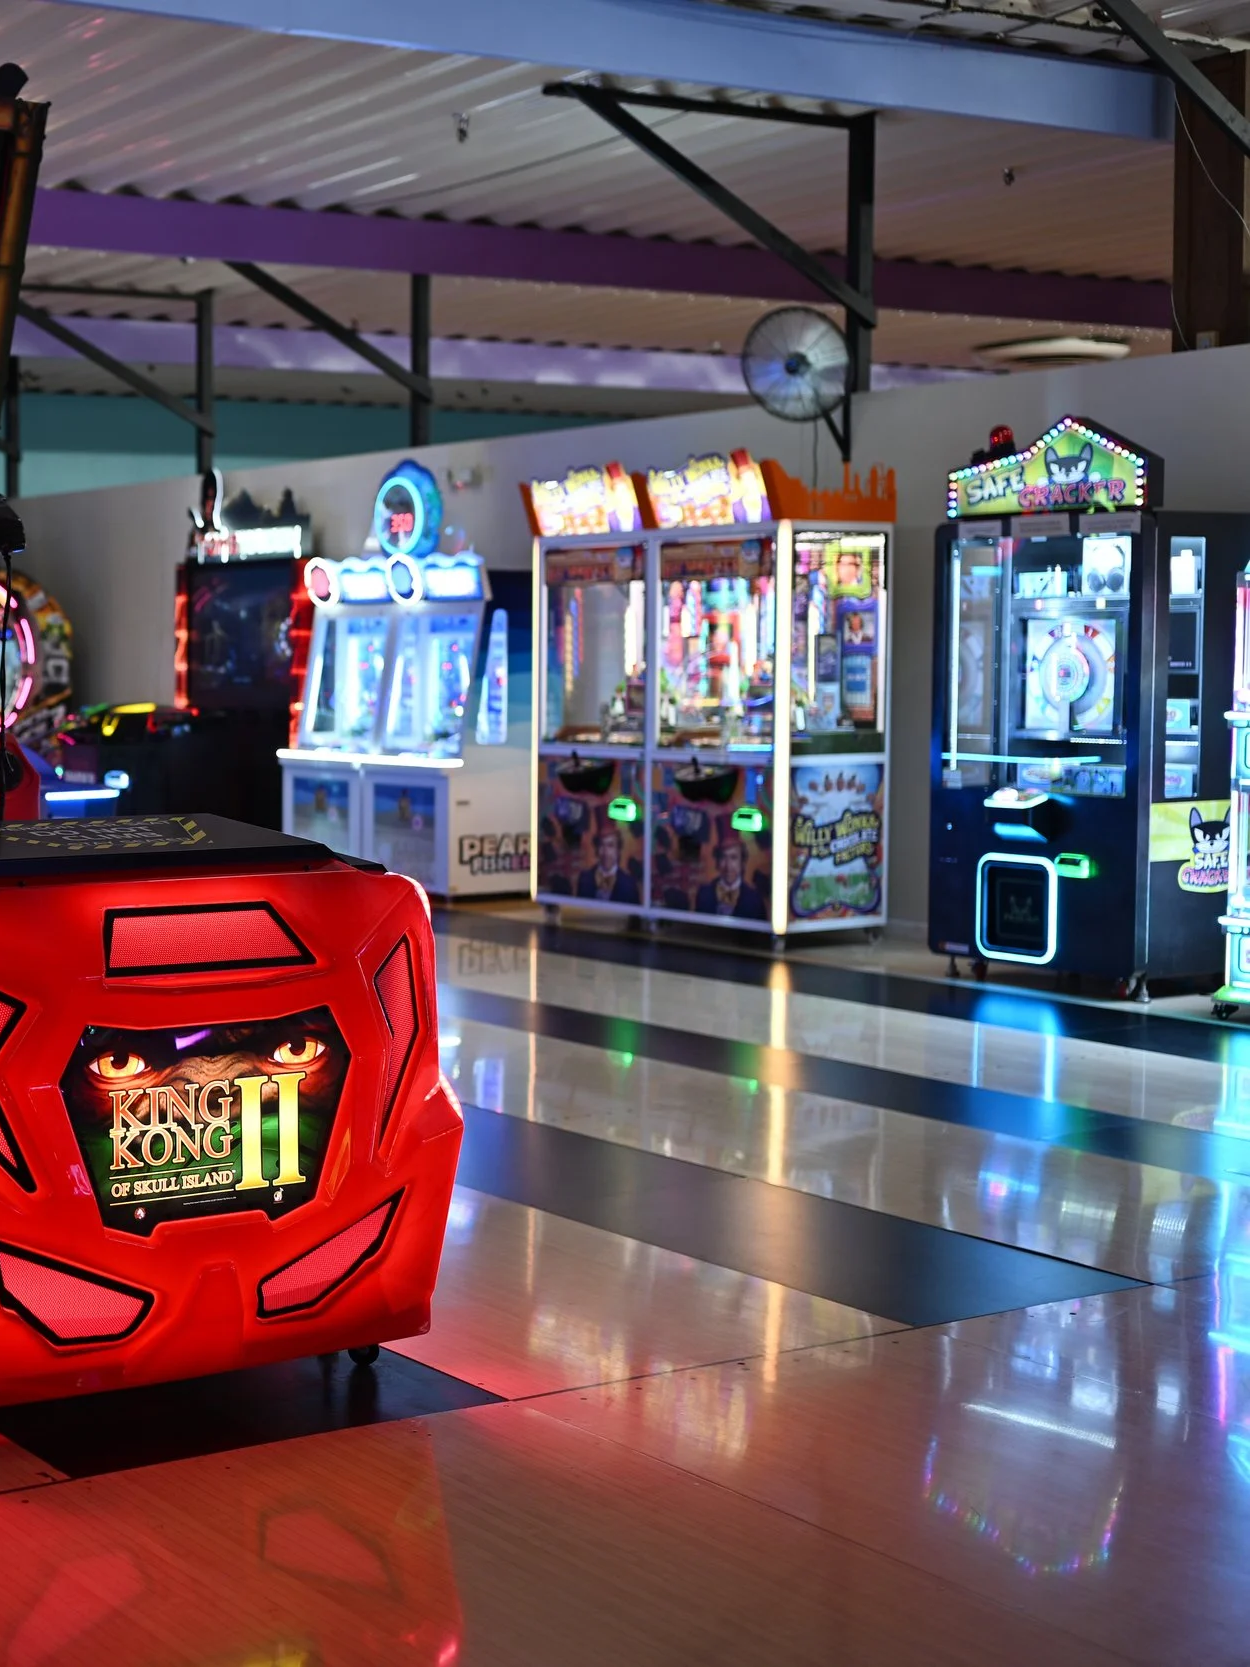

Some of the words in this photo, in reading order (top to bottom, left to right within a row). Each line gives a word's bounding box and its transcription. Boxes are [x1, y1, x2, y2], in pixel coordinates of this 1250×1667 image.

[966, 466, 1026, 506] SAFE
[29, 829, 80, 837] DO
[86, 826, 152, 834] NOT
[62, 831, 163, 841] CLIMB
[1195, 852, 1229, 870] SAFE
[109, 1079, 233, 1135] KING
[109, 1120, 233, 1170] KONG
[234, 1071, 306, 1191] II
[111, 1183, 131, 1198] OF
[133, 1177, 181, 1196] SKULL
[182, 1171, 234, 1189] ISLAND
